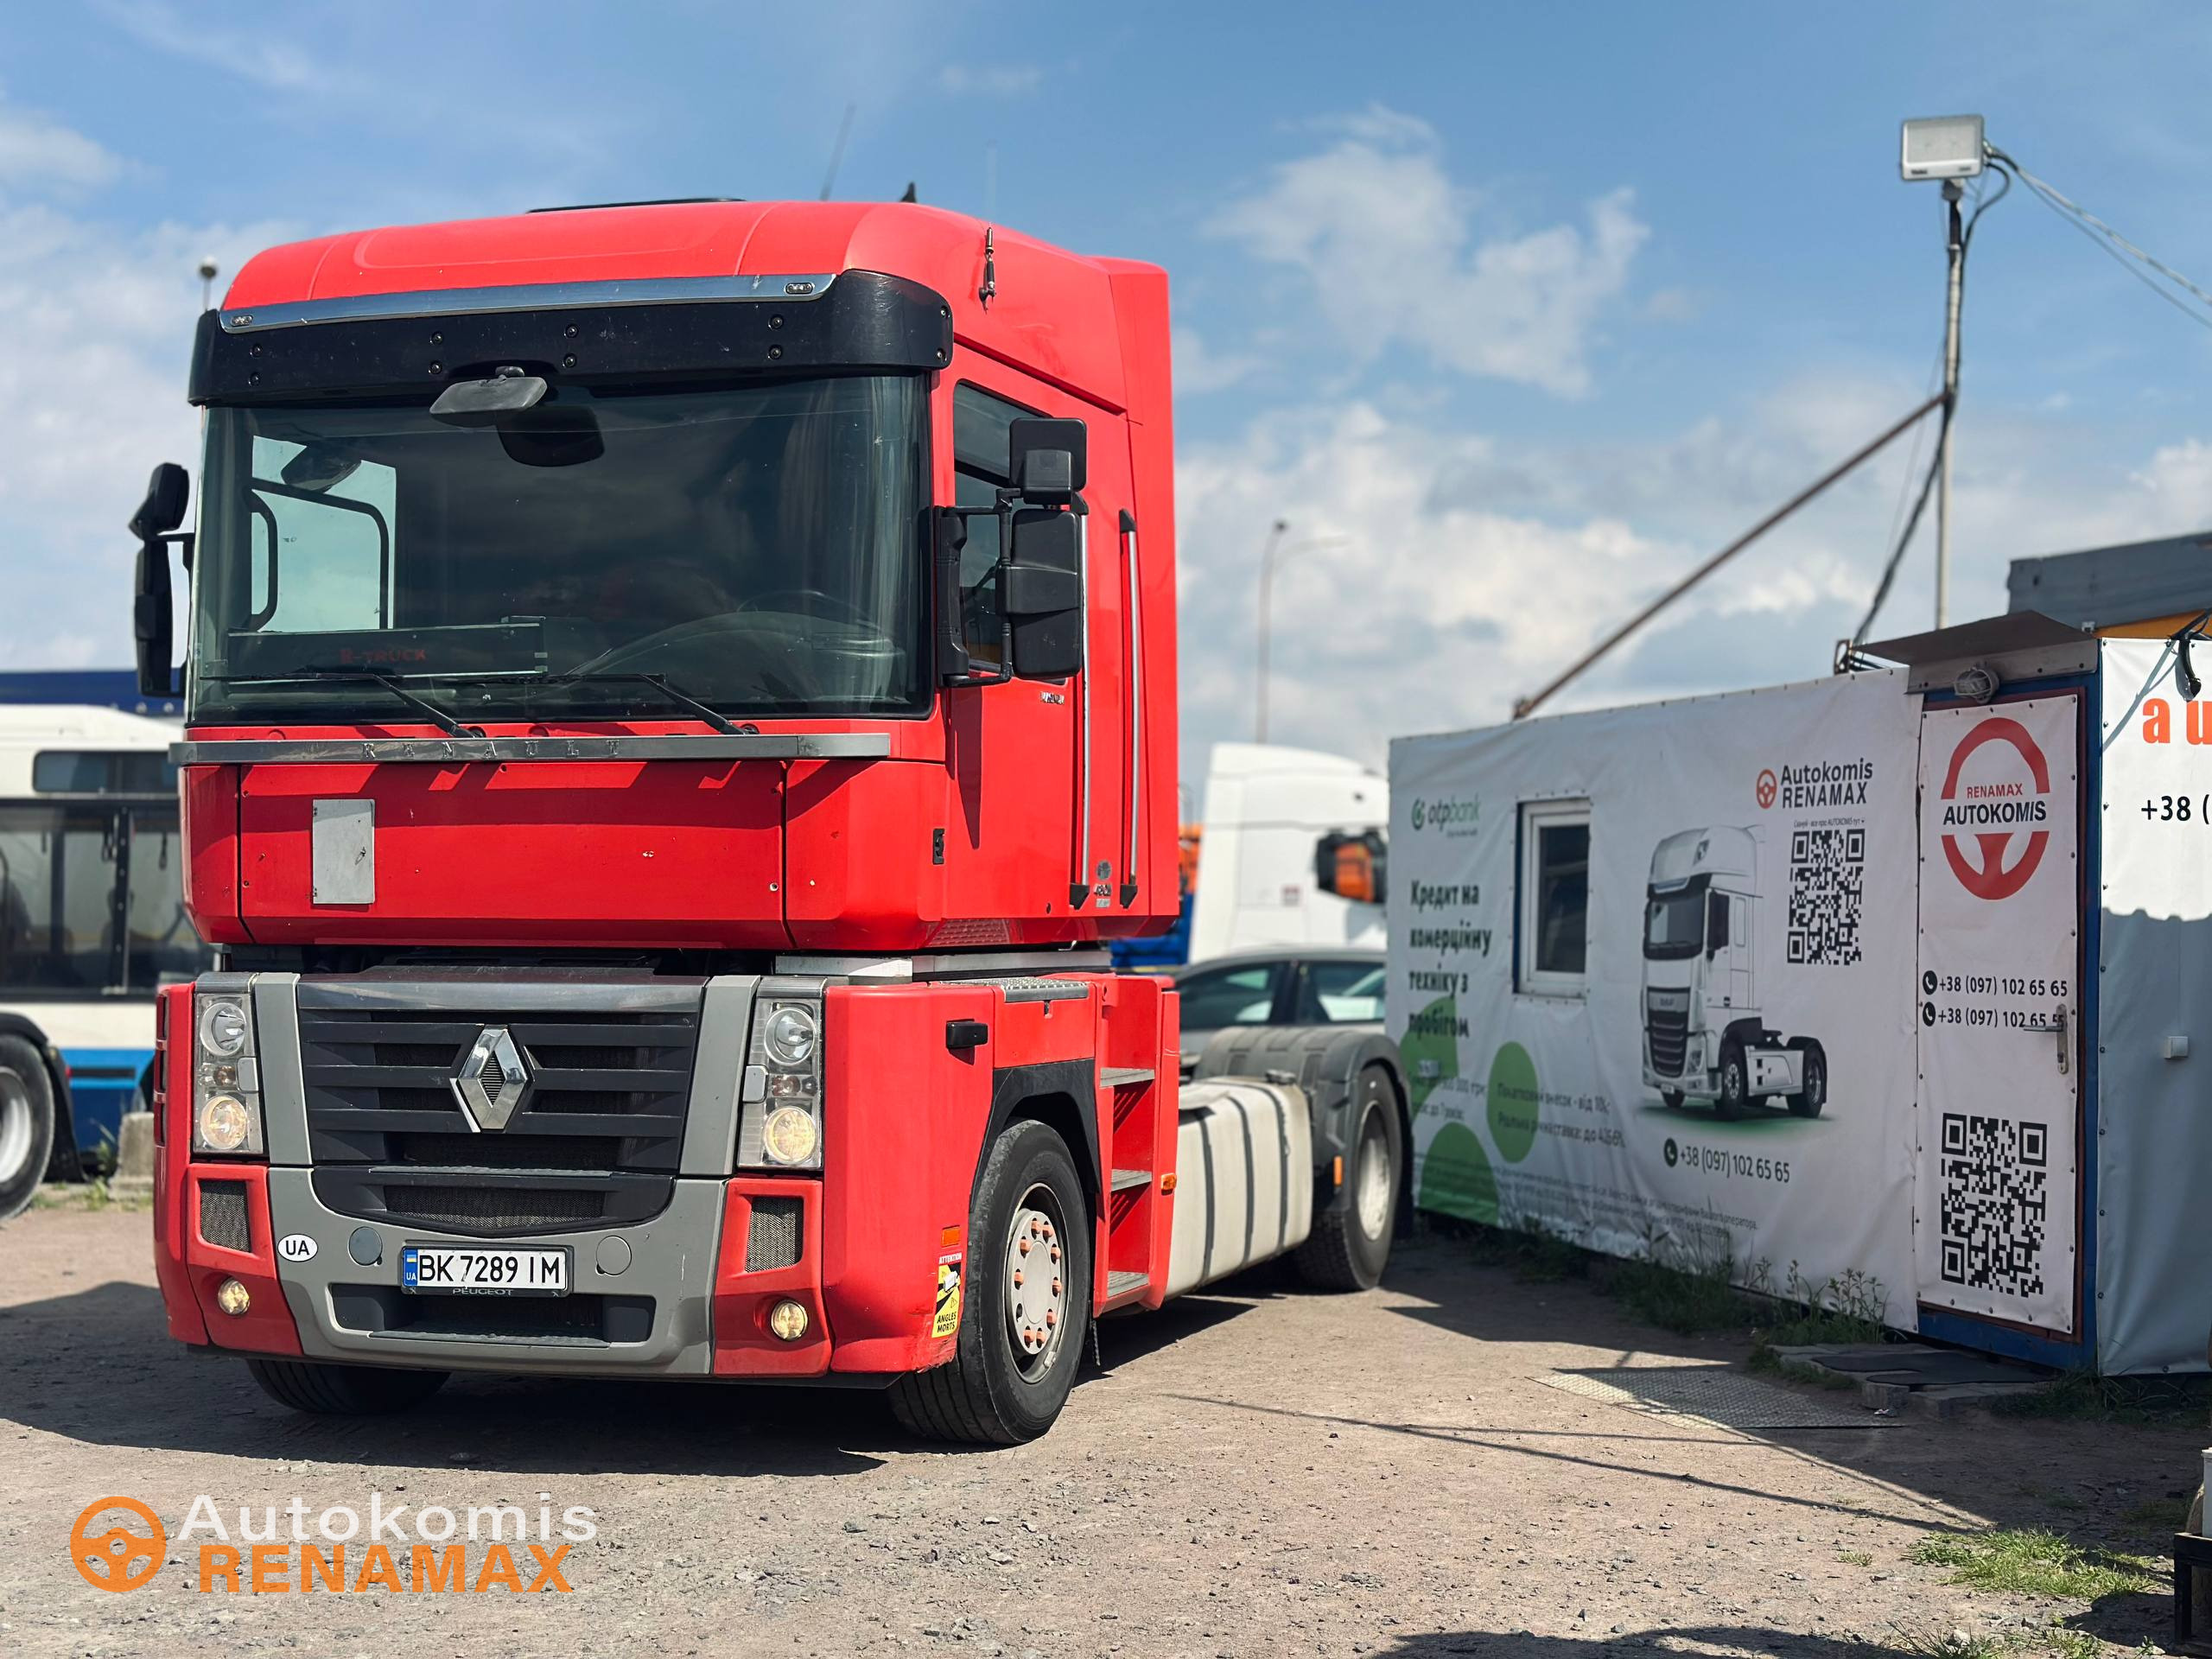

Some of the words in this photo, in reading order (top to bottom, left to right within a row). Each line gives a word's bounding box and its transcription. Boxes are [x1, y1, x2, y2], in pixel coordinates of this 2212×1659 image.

[1781, 757, 1872, 785] Autokomis
[1783, 781, 1867, 809] RENAMAX
[1967, 783, 2024, 798] RENAMAX
[1943, 801, 2047, 825] AUTOKOMIS
[2141, 796, 2191, 822] +38
[1411, 880, 1459, 912] Кредит
[1462, 885, 1479, 905] на
[1410, 919, 1492, 958] комерційну
[1409, 963, 1459, 999] техніку
[1461, 973, 1469, 993] з
[1939, 976, 1961, 992] +38
[1966, 976, 1997, 995] (097)
[2002, 978, 2025, 995] 102
[2030, 979, 2045, 995] 65
[2050, 980, 2068, 996] 65
[1408, 1007, 1470, 1039] пробігом
[1938, 1007, 1962, 1023] +38
[1966, 1007, 1998, 1027] (097)
[2003, 1012, 2025, 1027] 102
[2030, 1013, 2046, 1027] 65
[1681, 1146, 1700, 1166] +38
[1702, 1147, 1730, 1179] (097)
[1733, 1154, 1753, 1177] 102
[1757, 1158, 1771, 1179] 65
[1775, 1161, 1789, 1183] 65
[286, 1240, 310, 1255] UA
[406, 1272, 416, 1281] UA
[419, 1255, 454, 1282] BK
[461, 1255, 518, 1283] 7289
[529, 1256, 560, 1284] IM
[453, 1287, 514, 1296] PEUGEOT
[937, 1312, 957, 1324] ANGLES
[937, 1322, 955, 1332] MORTS
